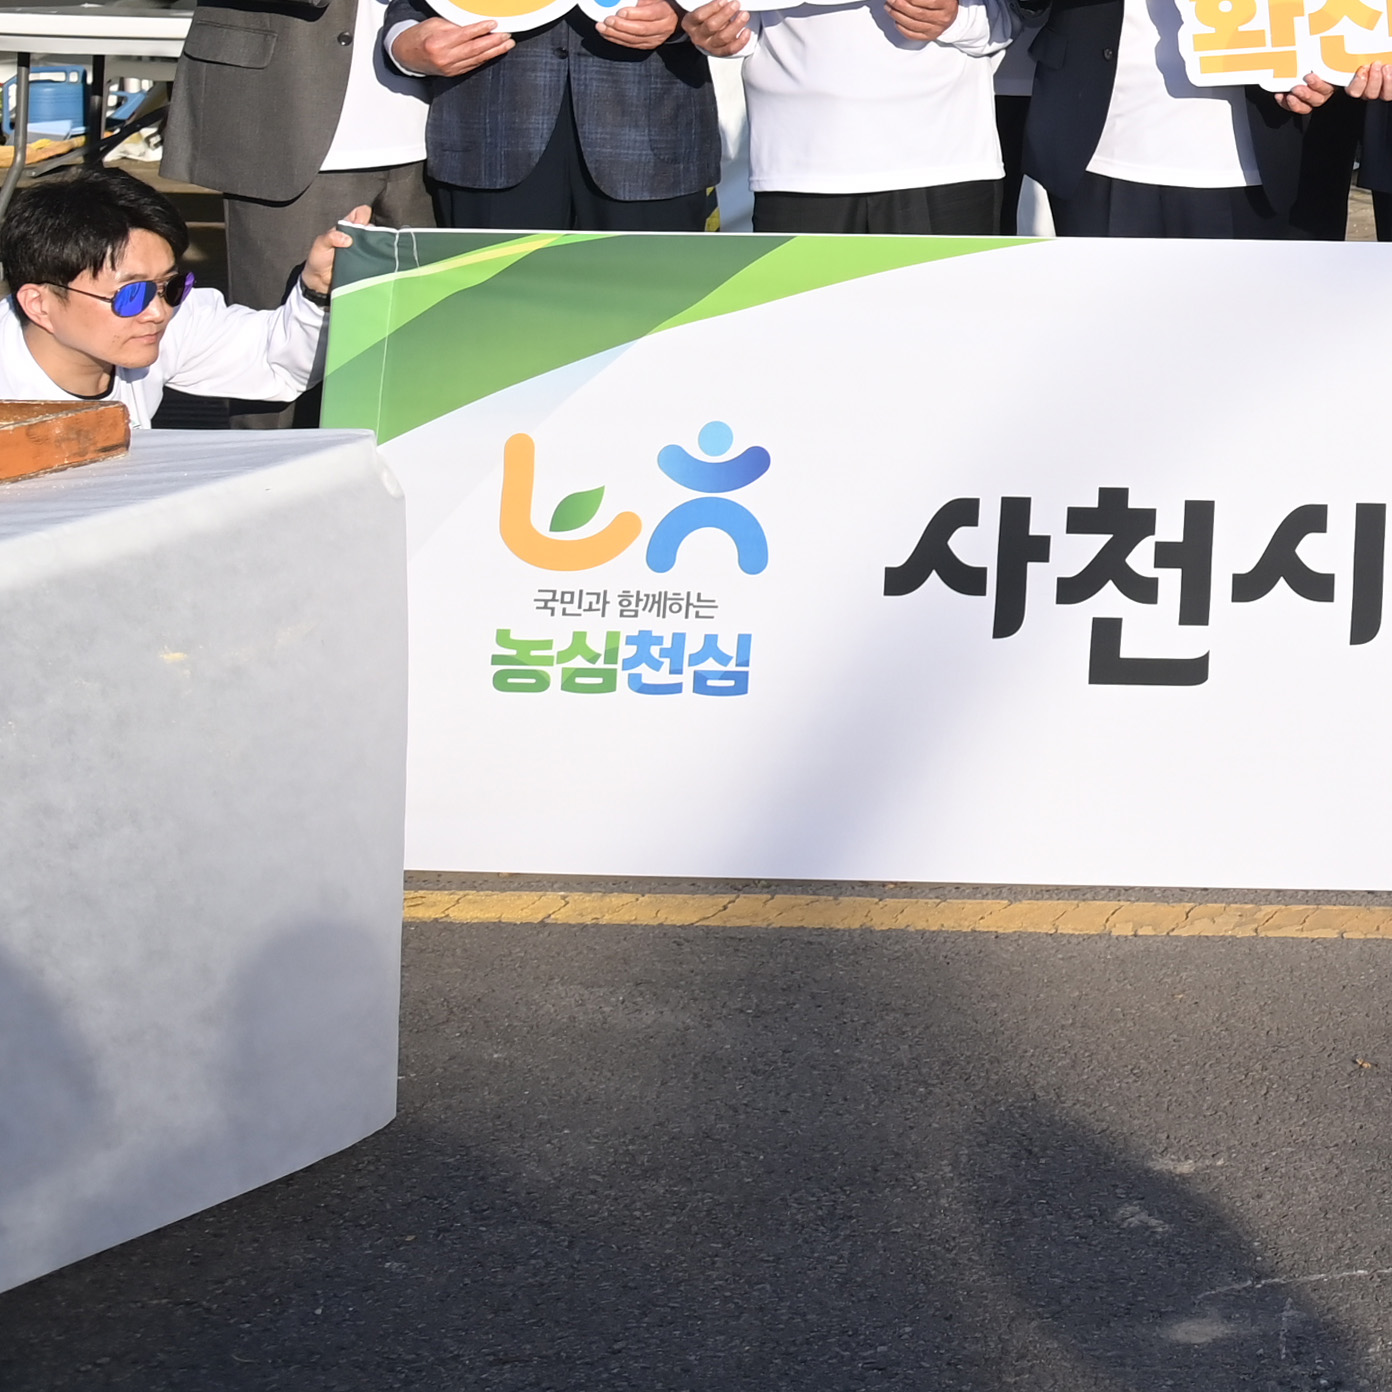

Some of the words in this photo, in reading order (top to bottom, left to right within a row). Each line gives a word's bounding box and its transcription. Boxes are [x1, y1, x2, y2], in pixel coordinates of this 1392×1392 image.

[533, 589, 610, 618] 국민과
[617, 590, 719, 619] 함께하는
[884, 486, 1387, 687] 사천시
[491, 628, 752, 697] 농심천심
